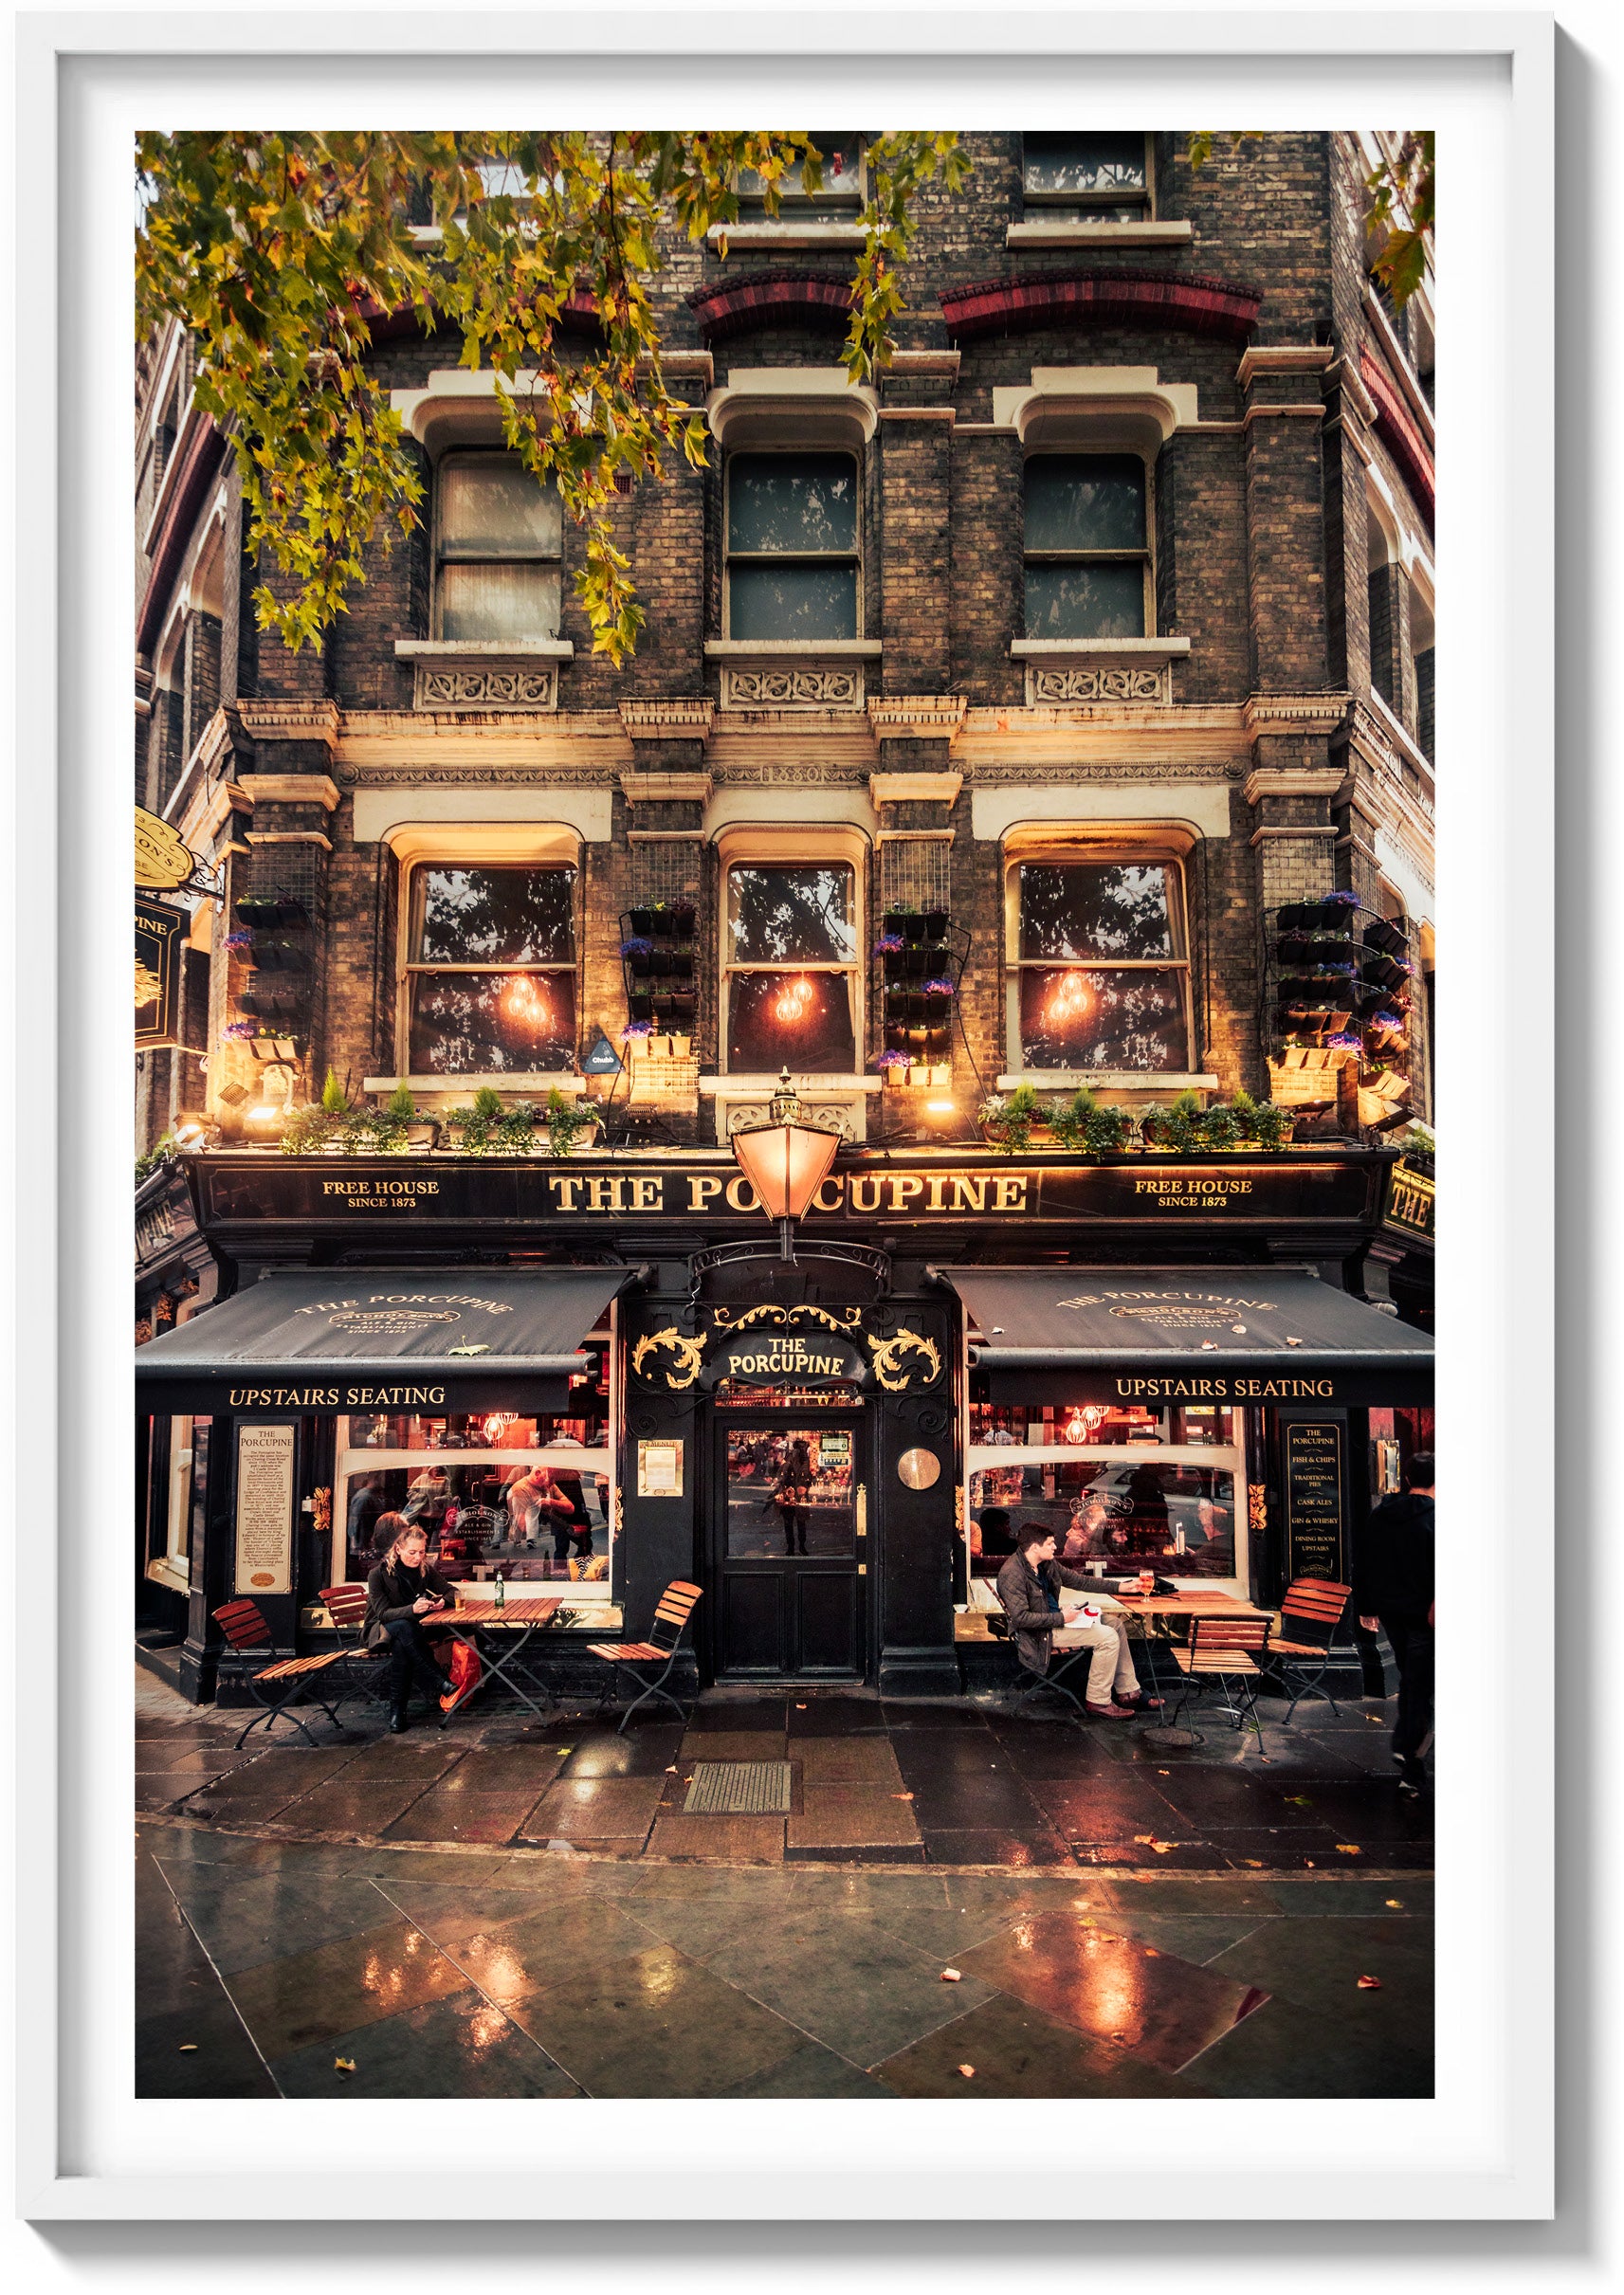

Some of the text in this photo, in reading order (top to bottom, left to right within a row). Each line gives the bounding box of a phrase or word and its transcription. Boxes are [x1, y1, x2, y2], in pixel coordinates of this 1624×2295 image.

[135, 834, 174, 866] ON'S
[322, 1181, 440, 1194] FREE HOUSE
[549, 1175, 1028, 1211] THE POCUPINE
[1135, 1180, 1252, 1193] FREE HOUSE
[348, 1197, 416, 1208] SINCE 1873
[1158, 1196, 1227, 1207] SINCE 1873
[1391, 1180, 1432, 1228] THE
[294, 1295, 514, 1316] THE PORCUPINE
[1056, 1291, 1279, 1312] THE PORCUPINE
[768, 1338, 806, 1353] THE
[728, 1354, 844, 1375] PORCUPINE
[229, 1386, 446, 1406] UPSTAIRS SEATING
[1116, 1378, 1334, 1397] UPSTAIRS SEATING
[241, 1438, 293, 1447] PORCUPINE
